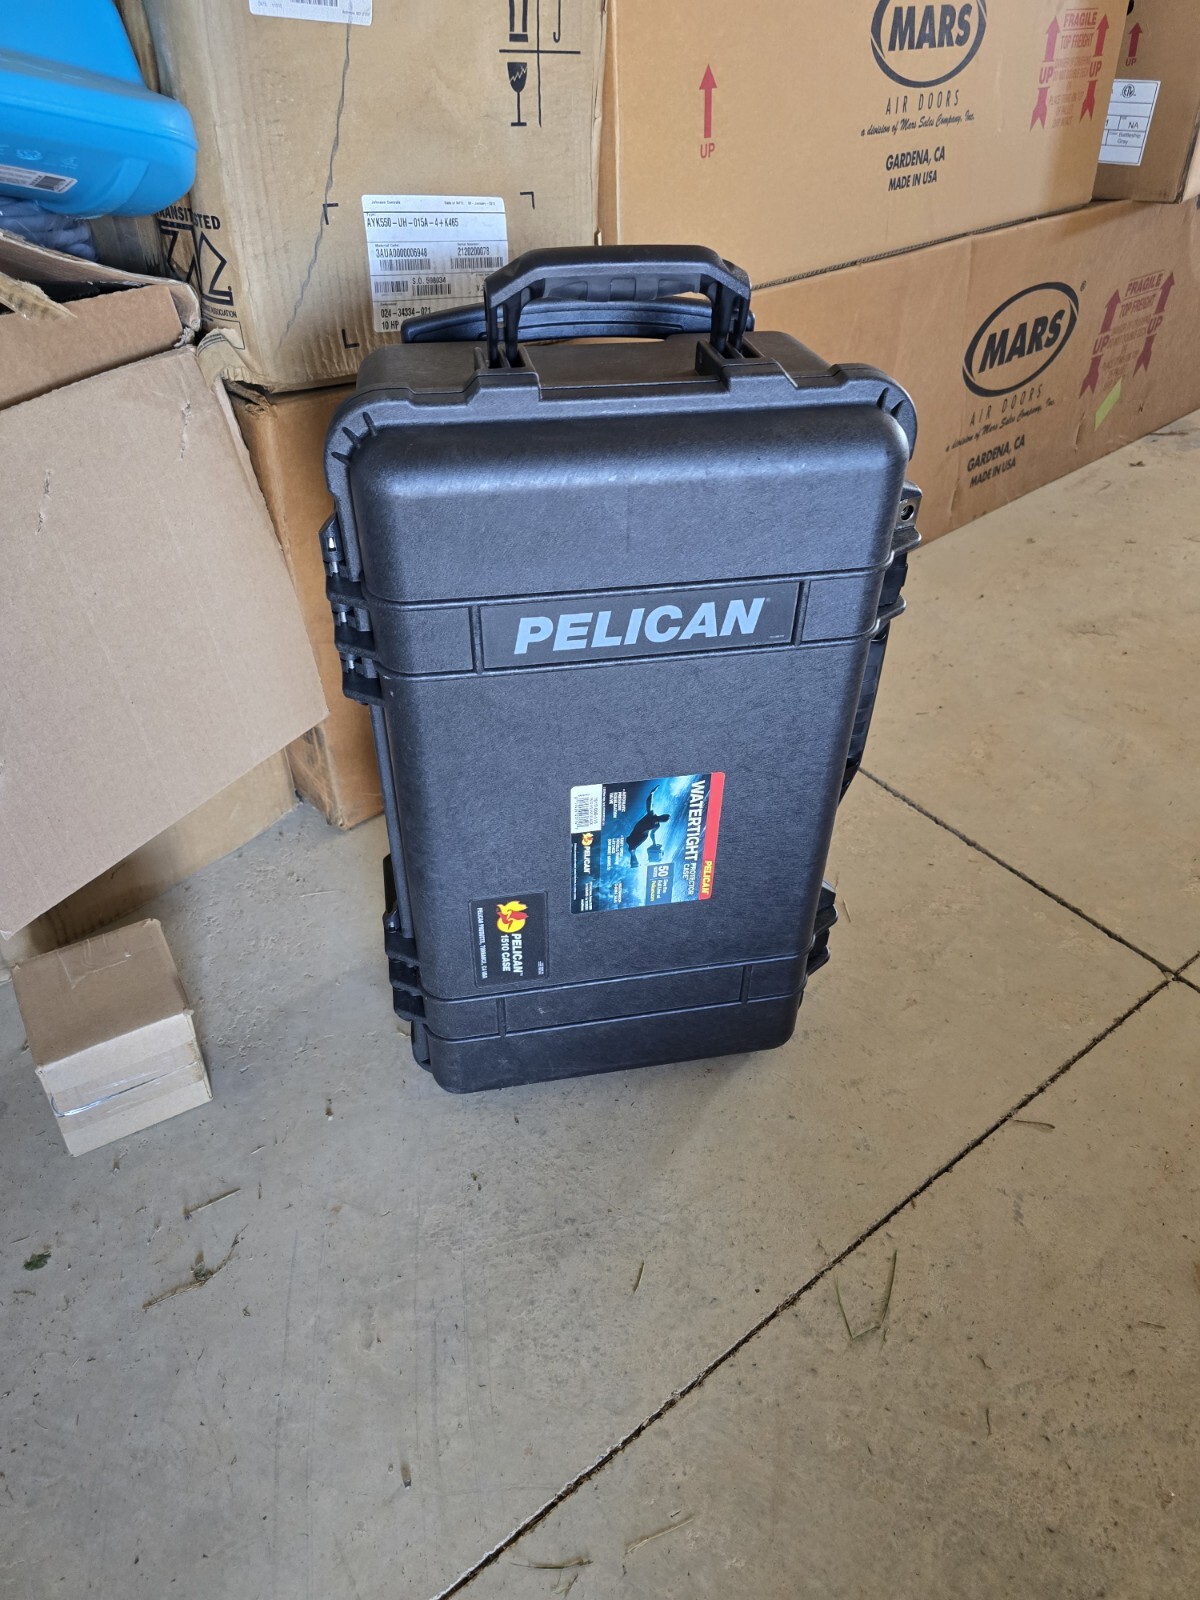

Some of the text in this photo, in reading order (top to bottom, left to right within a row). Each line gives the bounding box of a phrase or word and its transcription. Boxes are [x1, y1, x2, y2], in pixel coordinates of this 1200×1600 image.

[888, 3, 973, 51] MARS
[1064, 12, 1098, 27] FRAGILE
[1060, 32, 1095, 49] TOP FREIGHT
[1089, 61, 1103, 78] UP
[1125, 58, 1137, 66] UP
[1039, 66, 1055, 84] UP
[886, 89, 959, 115] AIR DOORS
[860, 129, 866, 137] a
[867, 125, 890, 136] division
[891, 121, 899, 135] of
[900, 118, 917, 131] Mars
[918, 116, 934, 128] Sales
[1128, 121, 1139, 129] NA
[700, 143, 716, 159] UP
[886, 146, 945, 172] GARDENA, CA
[888, 170, 937, 192] MADE IN USA
[156, 205, 192, 222] RANSIT
[1125, 273, 1164, 297] FRAGILE
[1119, 294, 1158, 318] TOP FREIGHT
[382, 320, 400, 330] 10 HP
[1147, 316, 1164, 334] UP
[978, 309, 1066, 373] MARS
[1092, 334, 1110, 355] UP
[969, 384, 1043, 427] AIR DOORS
[982, 423, 999, 435] Mars
[999, 415, 1016, 429] Sales
[967, 434, 1025, 472] GARDENA, CA
[969, 455, 1016, 488] MADE IN USA
[514, 597, 765, 655] PELICAN
[684, 780, 705, 896] WATERTIGHT PROTECTOR
[658, 865, 669, 877] 50
[702, 860, 713, 895] PELICAN
[476, 907, 484, 924] PELICAN
[501, 935, 511, 972] 1510 CASE
[512, 933, 523, 973] PELICAN
